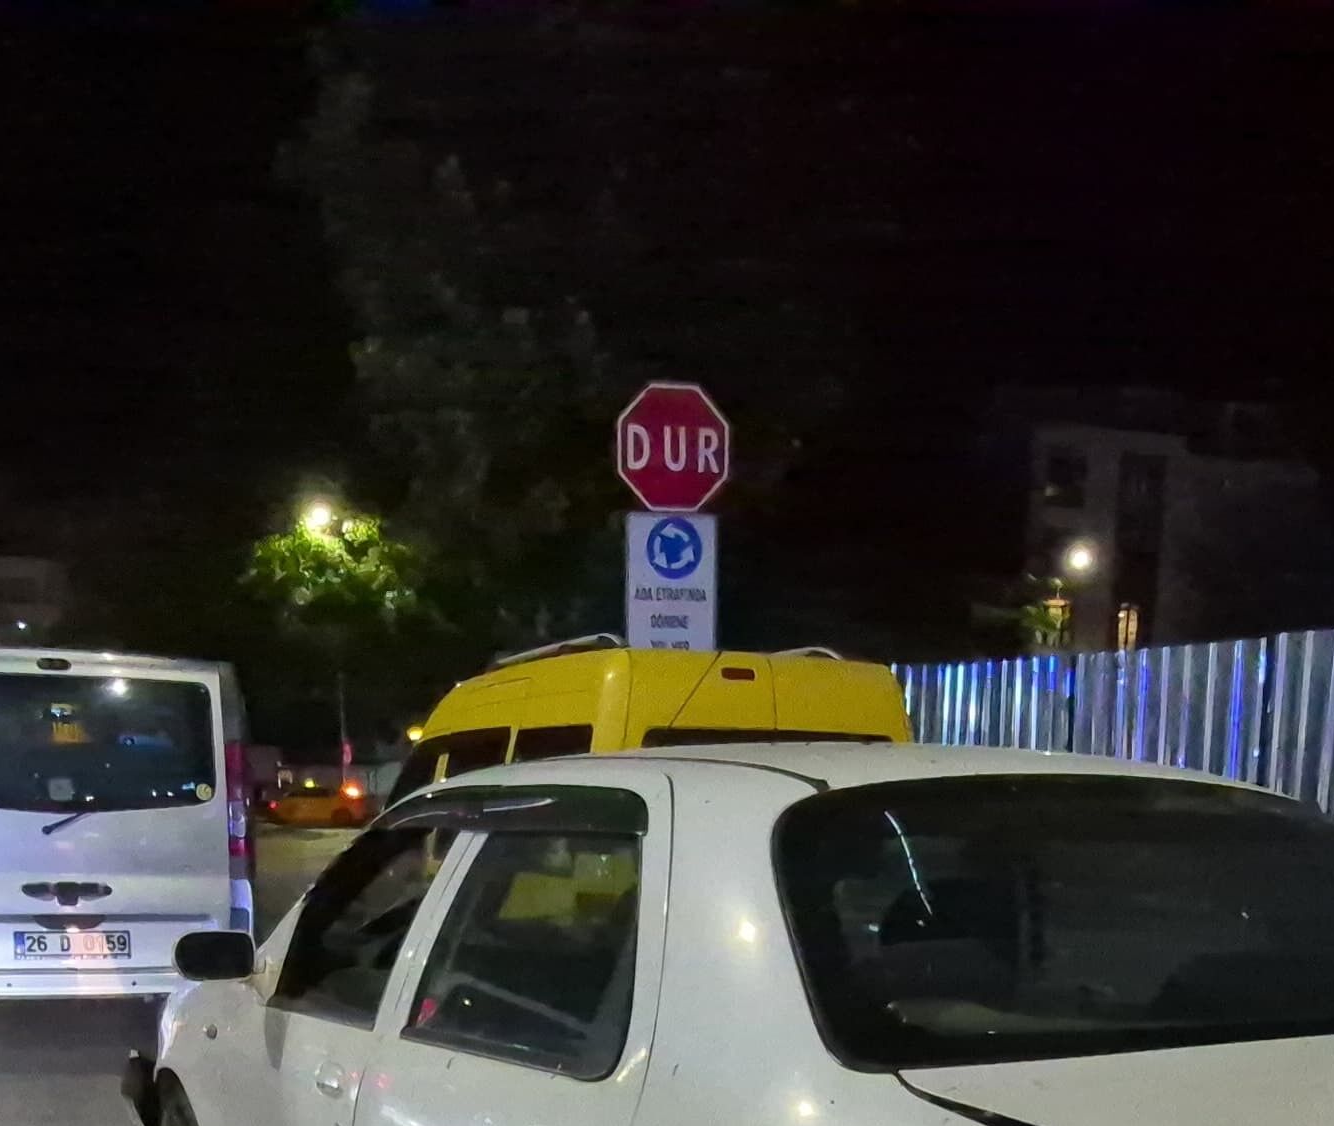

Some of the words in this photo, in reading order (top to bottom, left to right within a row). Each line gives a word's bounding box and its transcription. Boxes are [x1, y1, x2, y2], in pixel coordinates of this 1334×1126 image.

[626, 423, 719, 474] DUR
[26, 934, 48, 953] 26
[59, 934, 71, 952] D
